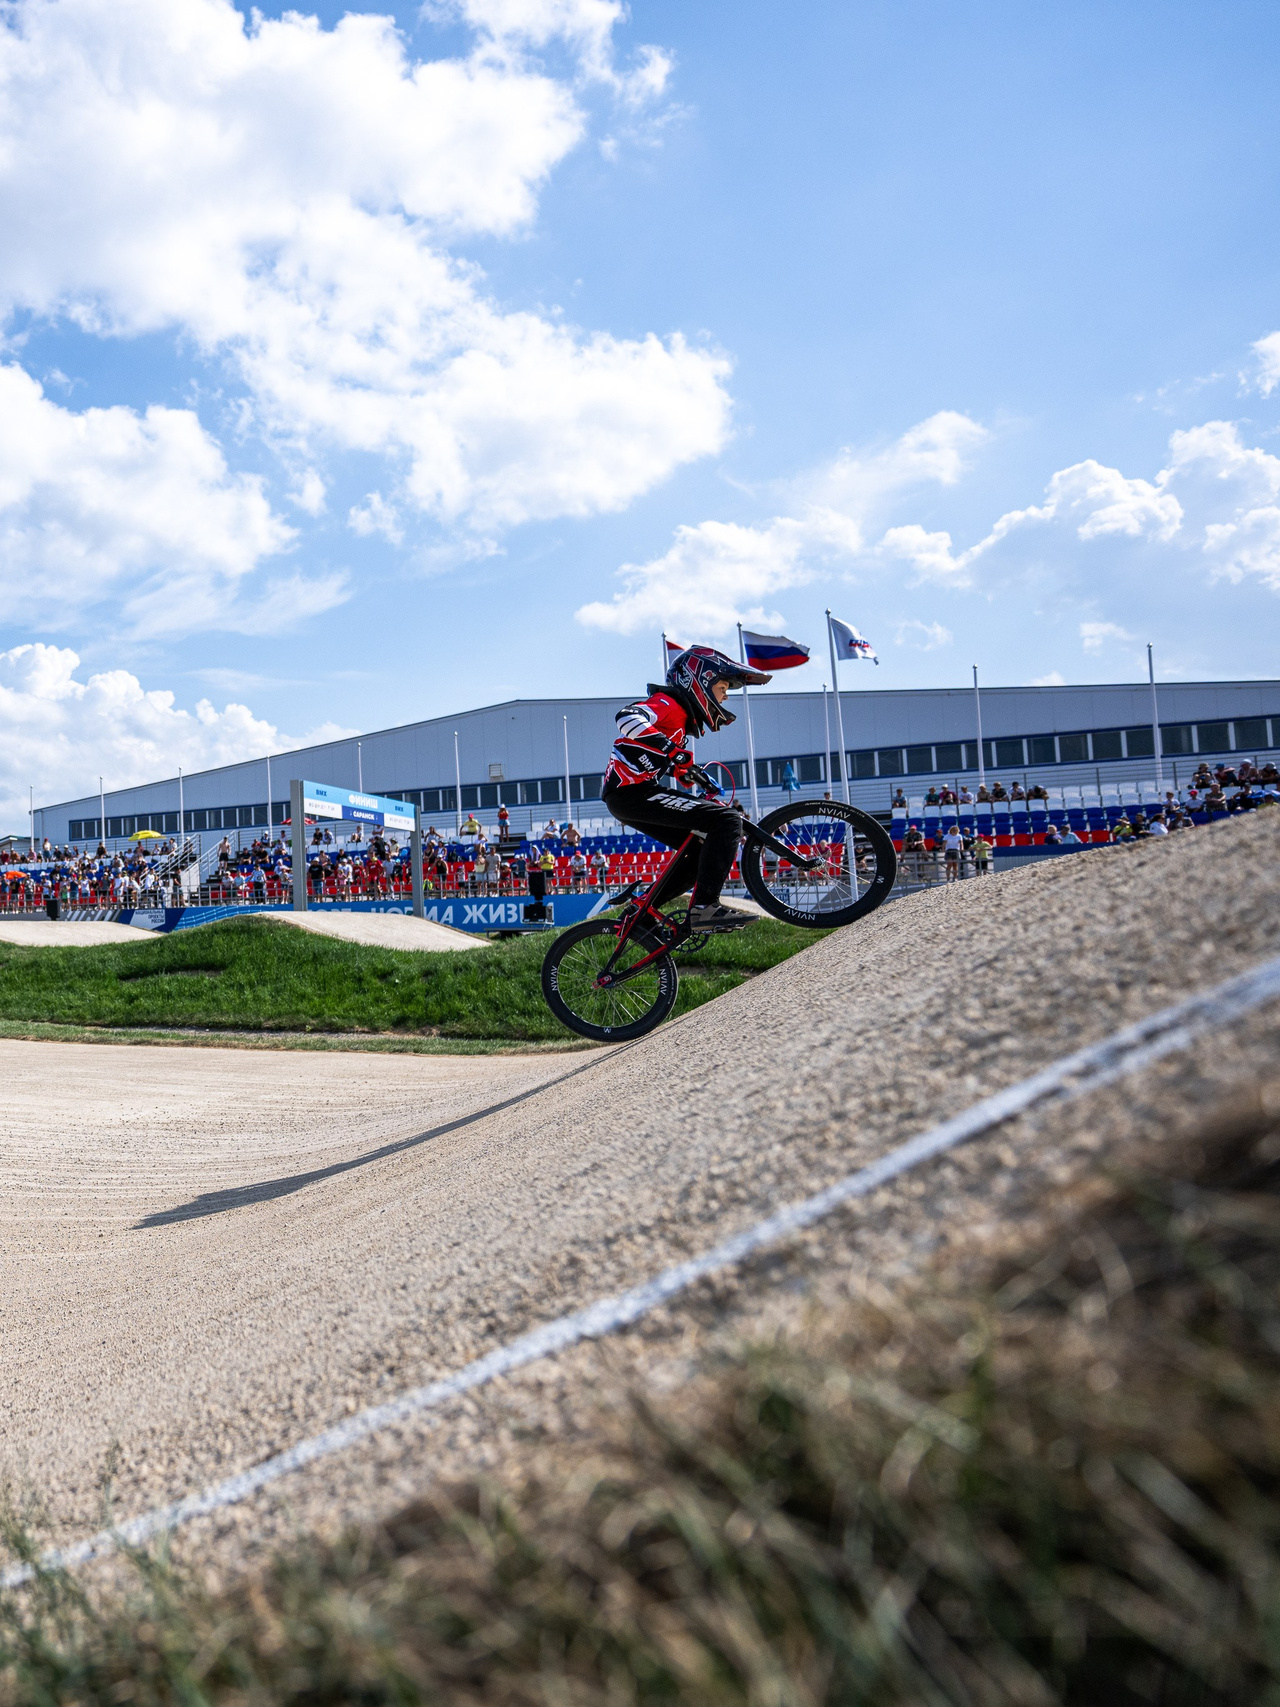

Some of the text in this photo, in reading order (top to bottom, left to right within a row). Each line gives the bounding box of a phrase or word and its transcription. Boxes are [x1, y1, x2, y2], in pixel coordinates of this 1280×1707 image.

[638, 753, 655, 771] BMX
[315, 789, 327, 797] BMX
[348, 794, 379, 809] ФИНИШ
[352, 810, 375, 821] САРАНСК
[818, 807, 851, 819] AVIAN
[462, 902, 555, 925] ЖИЗ
[783, 908, 816, 921] AVIAN
[550, 966, 558, 991] AVIAN
